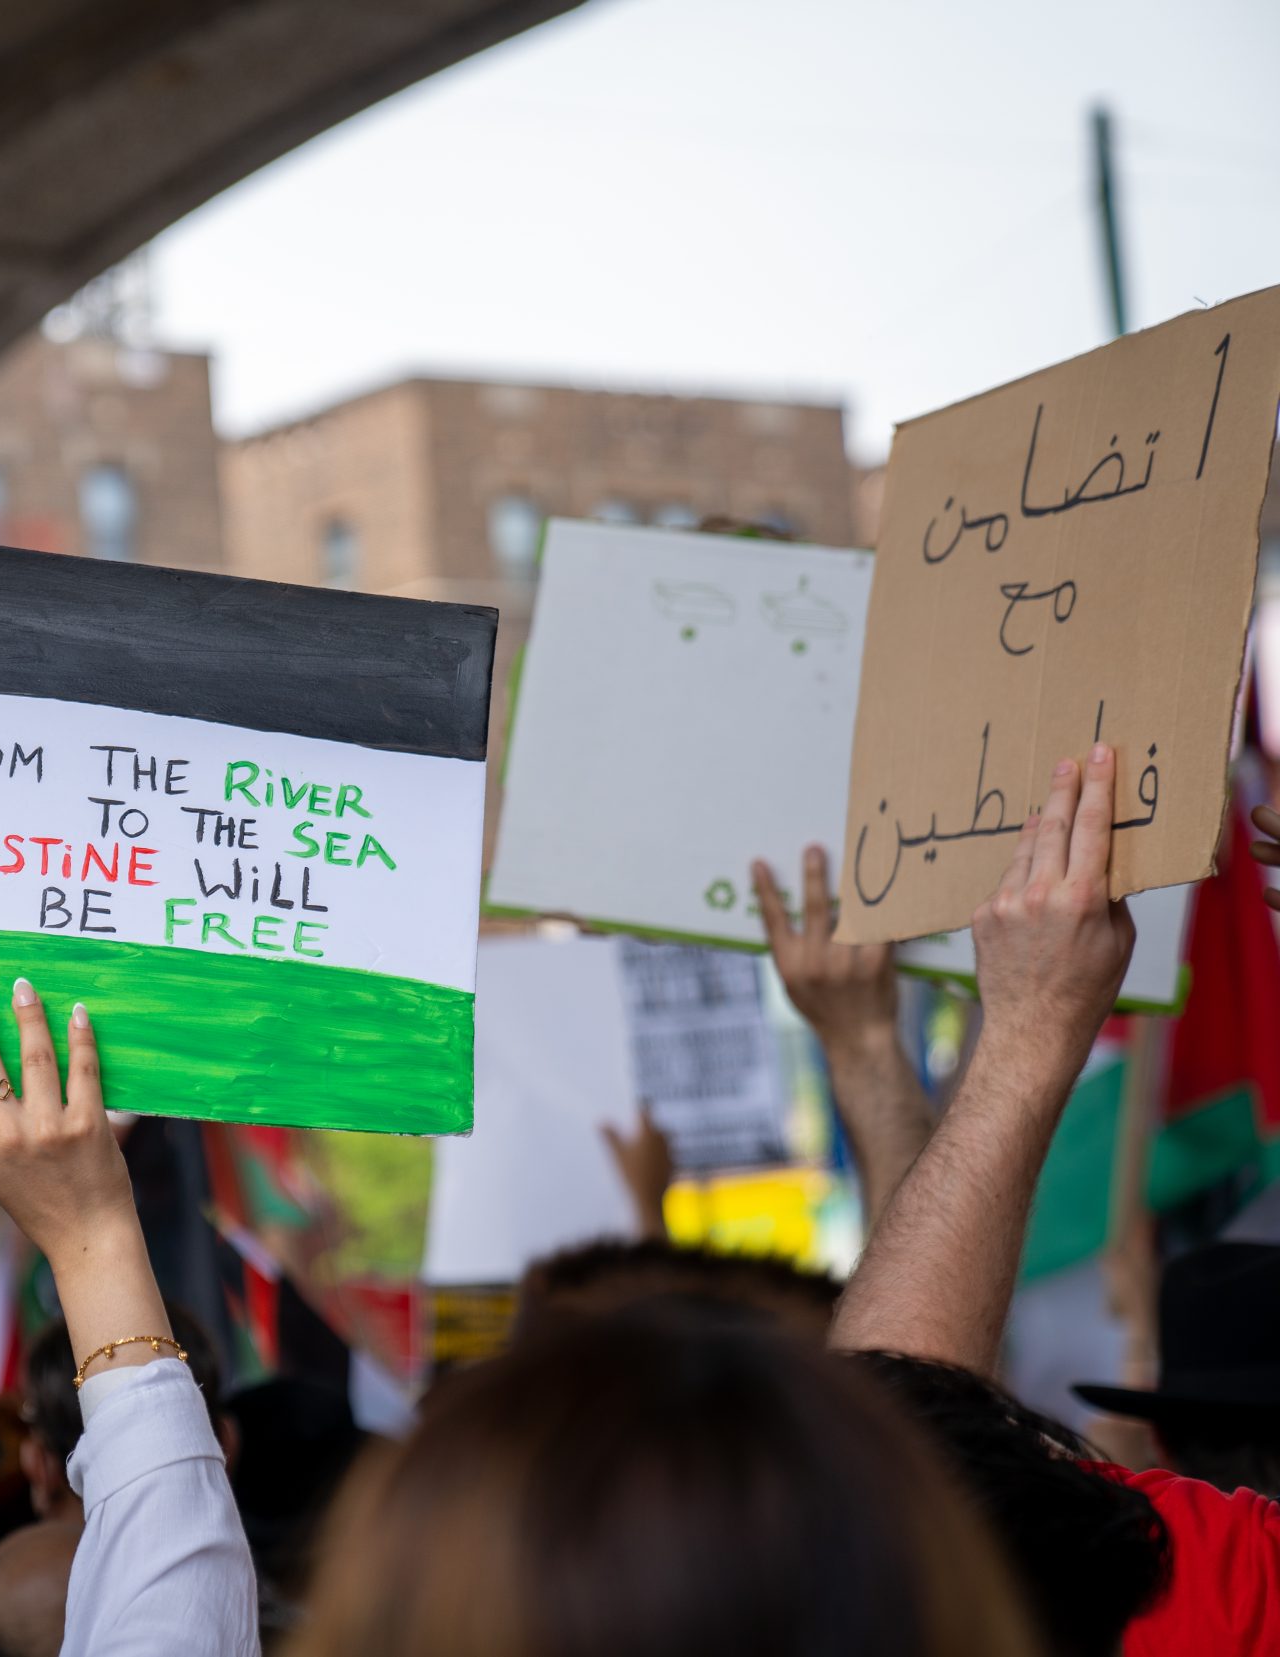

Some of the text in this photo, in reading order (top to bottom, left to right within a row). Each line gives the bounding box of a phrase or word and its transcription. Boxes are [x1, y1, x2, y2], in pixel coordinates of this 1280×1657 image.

[999, 580, 1077, 656] مع
[89, 745, 190, 795] THE
[87, 797, 397, 871] TO THE SEA
[39, 886, 328, 957] BE FREE
